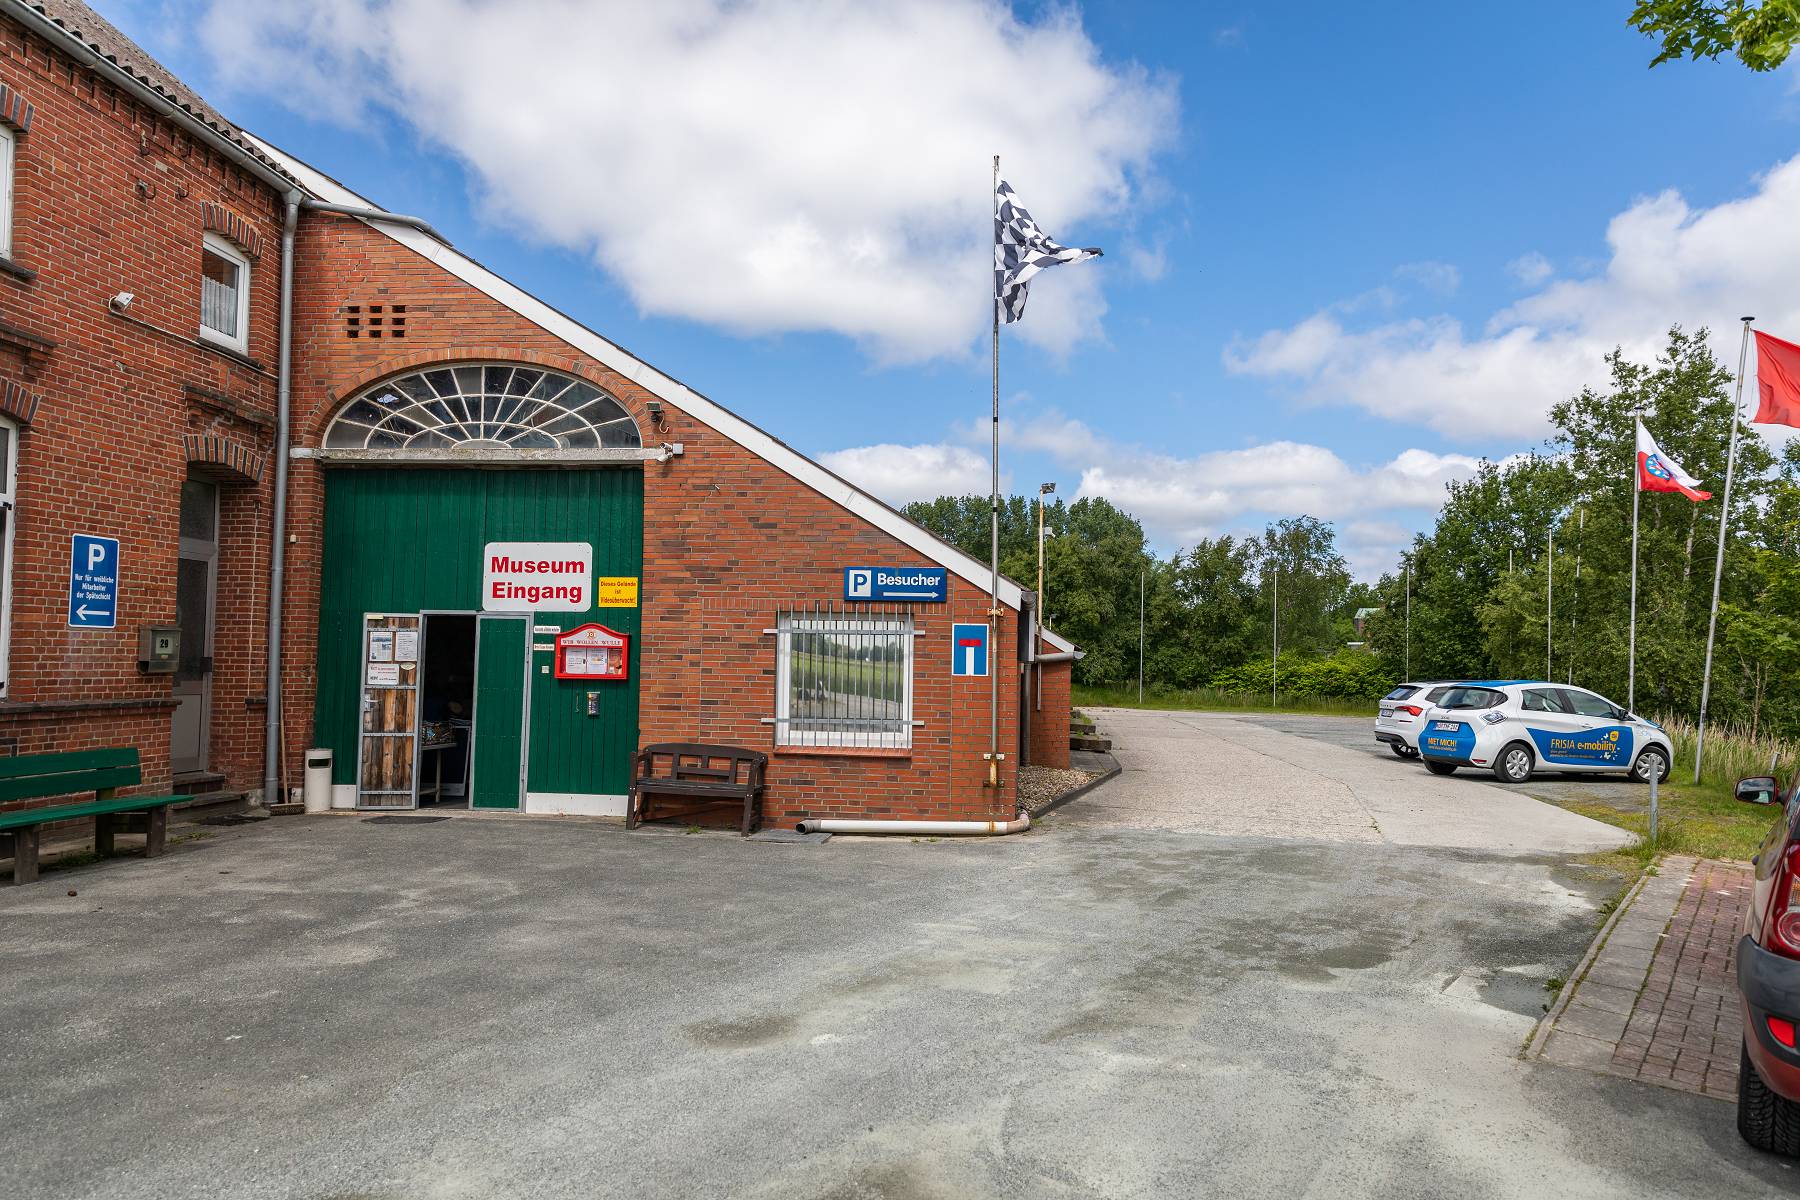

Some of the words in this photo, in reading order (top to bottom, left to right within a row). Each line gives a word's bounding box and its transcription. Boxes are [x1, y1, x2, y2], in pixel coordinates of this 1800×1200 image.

[88, 543, 105, 570] P
[491, 556, 585, 574] Museum
[74, 573, 83, 581] Nur
[93, 575, 114, 583] weibliche
[853, 573, 868, 593] P
[877, 572, 940, 586] Besucher
[82, 583, 106, 591] Mitarbeiter
[492, 582, 582, 604] Eingang
[76, 591, 84, 599] der
[86, 591, 111, 600] Spätschicht
[1550, 738, 1575, 749] FRISIA
[1577, 740, 1617, 752] e-mobility
